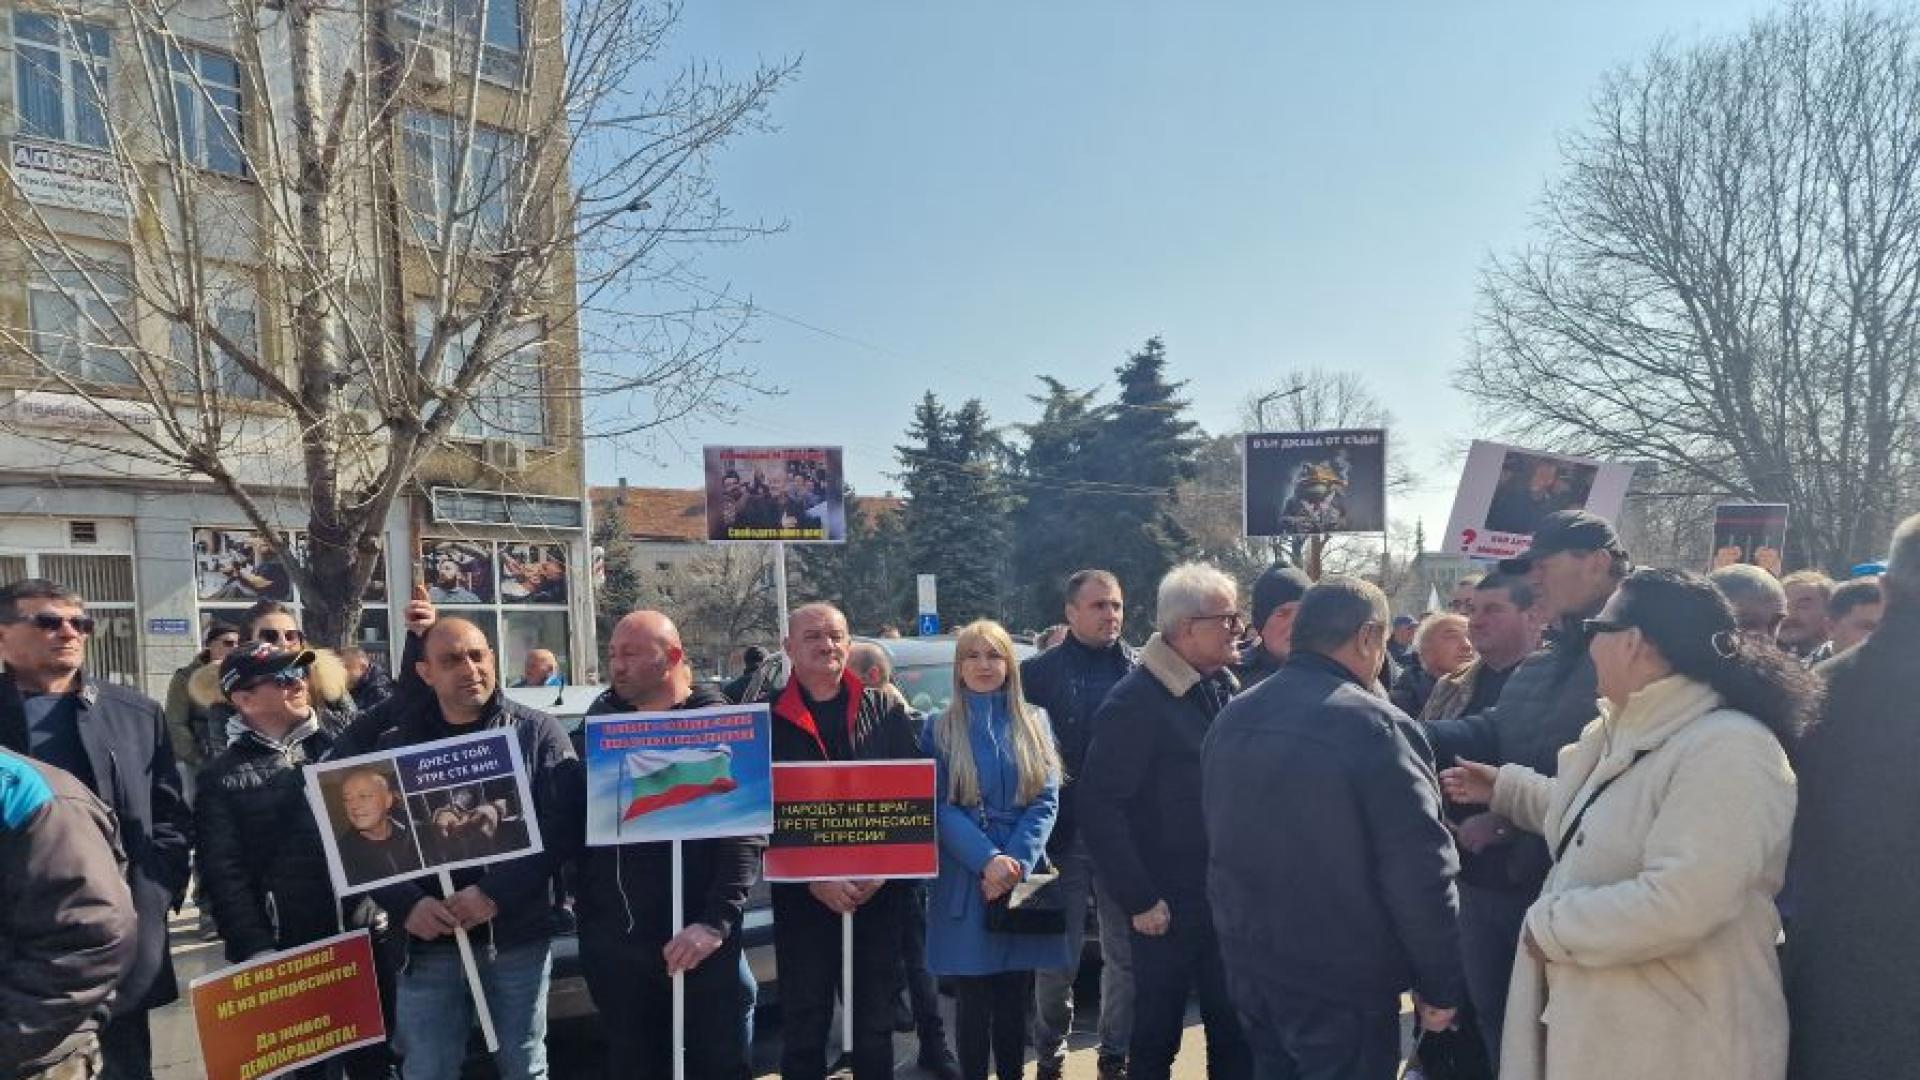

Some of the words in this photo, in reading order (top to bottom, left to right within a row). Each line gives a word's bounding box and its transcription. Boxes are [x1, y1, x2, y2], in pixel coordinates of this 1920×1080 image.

[1326, 435, 1341, 446] ОТ
[418, 753, 451, 771] ДНЕС
[452, 751, 460, 762] Е
[416, 770, 445, 785] УТРЕ
[447, 764, 469, 779] СТЕ
[781, 803, 843, 817] НАРОДЪТ
[848, 802, 865, 814] НЕ
[867, 802, 876, 813] Е
[773, 818, 818, 830] ПРЕТЕ
[822, 815, 932, 829] ПОЛИТИЧЕСКИТЕ
[232, 971, 252, 991] НЕ
[254, 967, 273, 985] на
[277, 947, 335, 977] страха!
[215, 1002, 235, 1020] НЕ
[237, 995, 256, 1013] на
[259, 961, 358, 1006] репресиите!
[240, 1023, 358, 1080] ДЕМОКРАЦИЯТА!
[256, 1032, 278, 1053] Да
